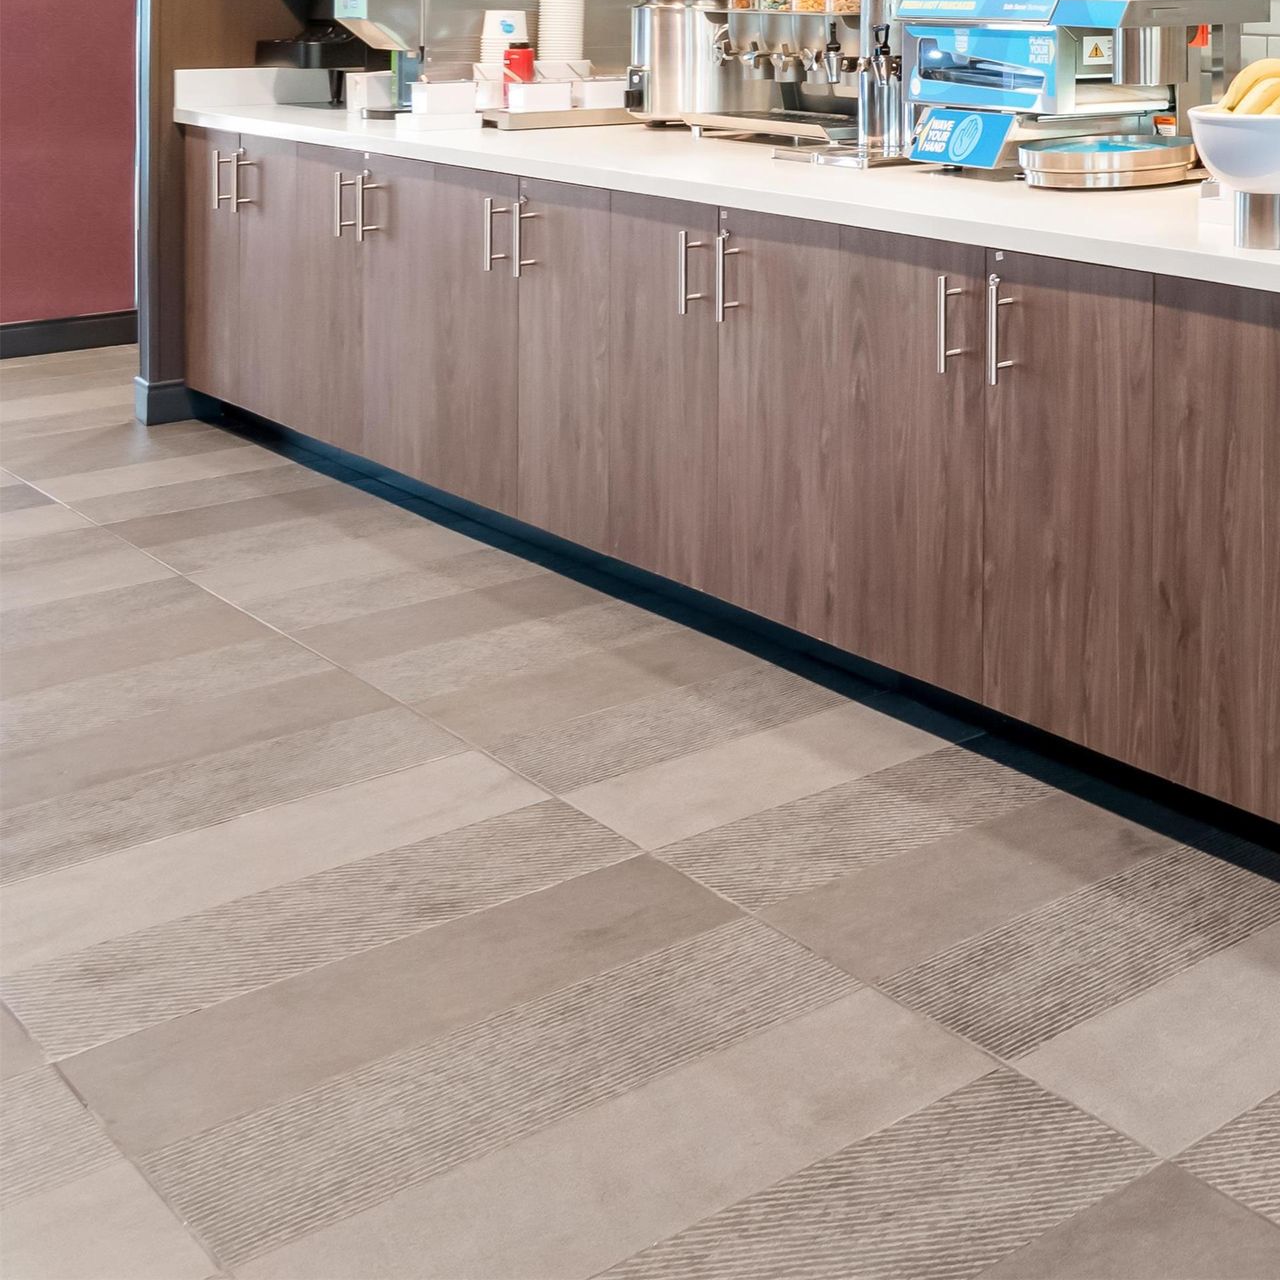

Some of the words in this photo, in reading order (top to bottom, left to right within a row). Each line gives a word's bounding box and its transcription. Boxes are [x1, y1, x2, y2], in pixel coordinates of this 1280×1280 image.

[1030, 45, 1049, 54] YOUR
[1029, 54, 1050, 64] PLATE
[931, 119, 955, 130] WAVE
[928, 129, 951, 141] YOUR
[922, 140, 946, 153] HAND
